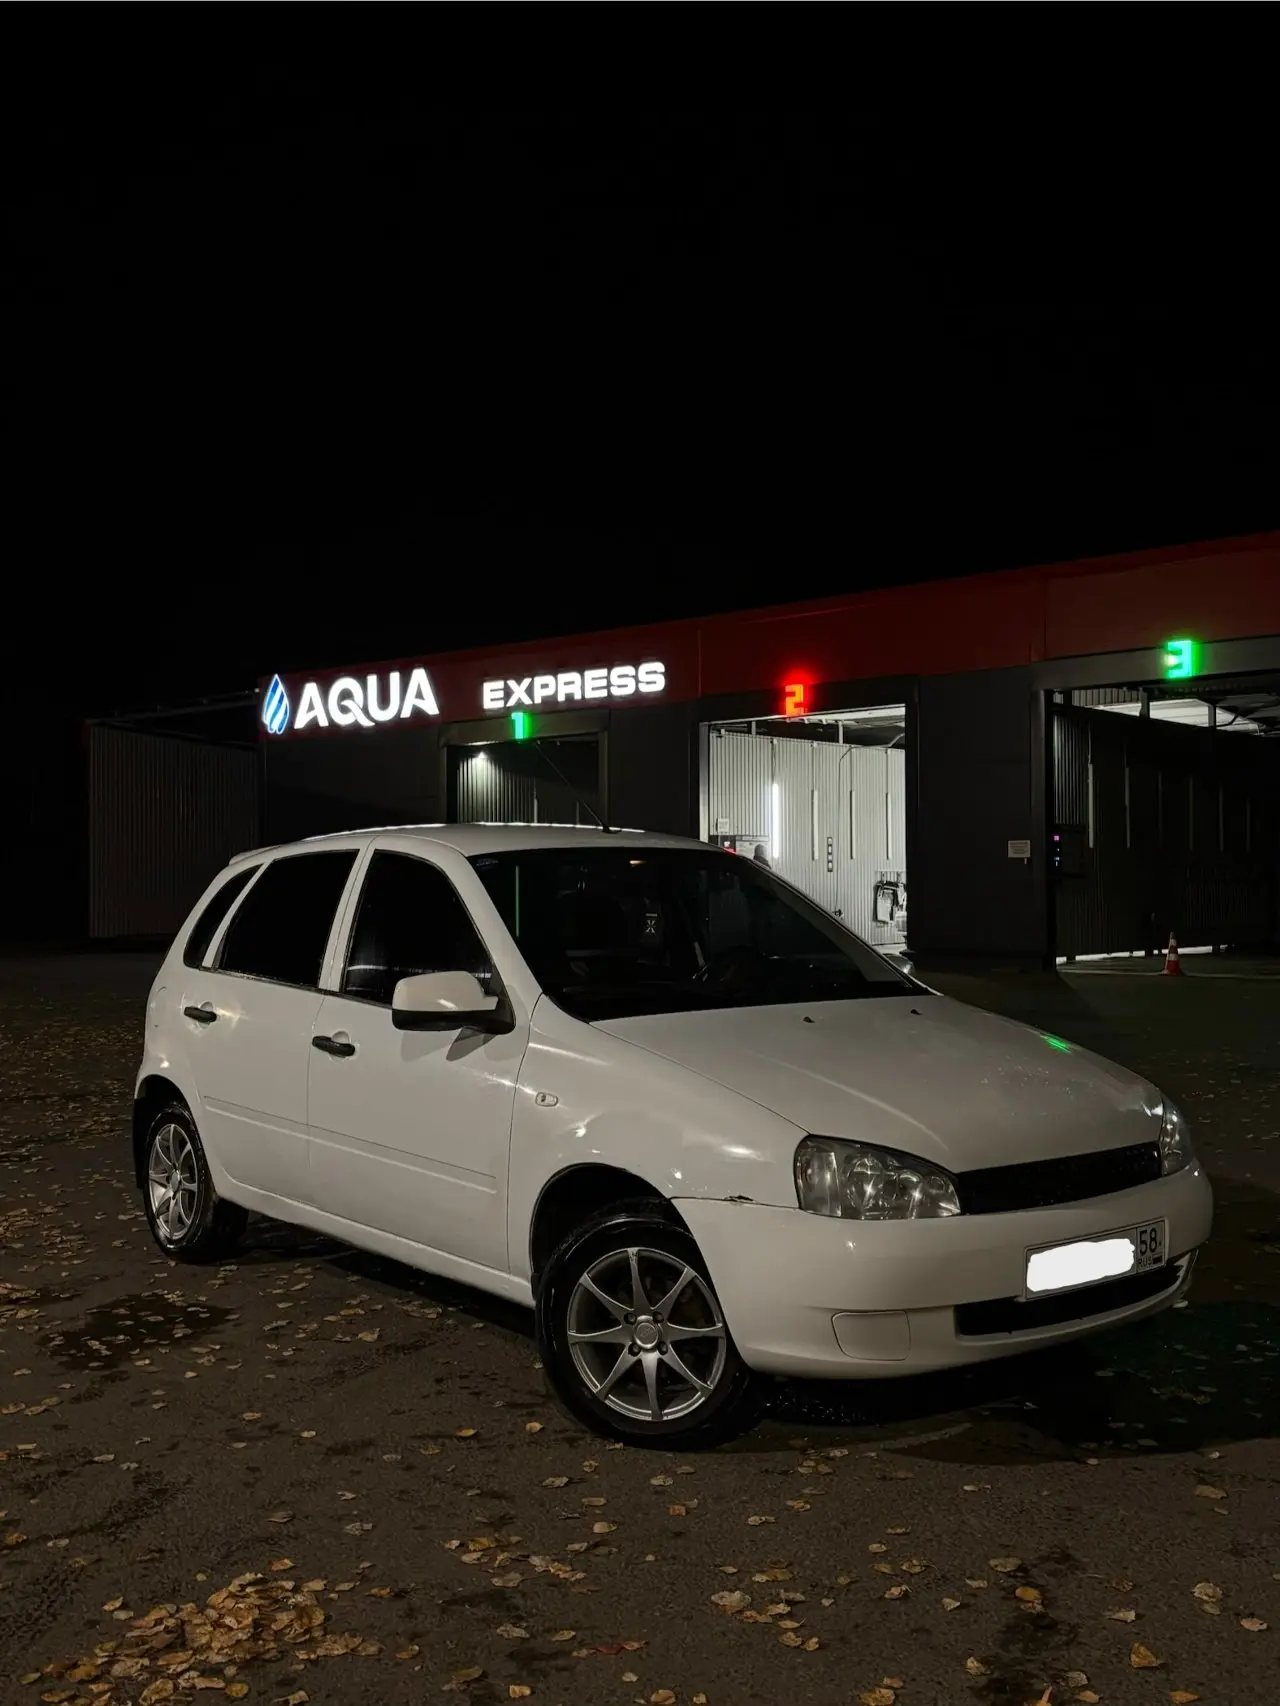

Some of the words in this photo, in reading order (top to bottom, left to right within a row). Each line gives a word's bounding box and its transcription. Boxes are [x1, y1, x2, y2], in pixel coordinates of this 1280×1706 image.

[1165, 640, 1192, 679] 3
[293, 667, 440, 728] AQUA
[482, 661, 666, 709] EXPRESS
[785, 684, 804, 717] 2
[511, 711, 524, 740] 1
[1139, 1227, 1158, 1256] 58
[1138, 1255, 1152, 1268] RUS
